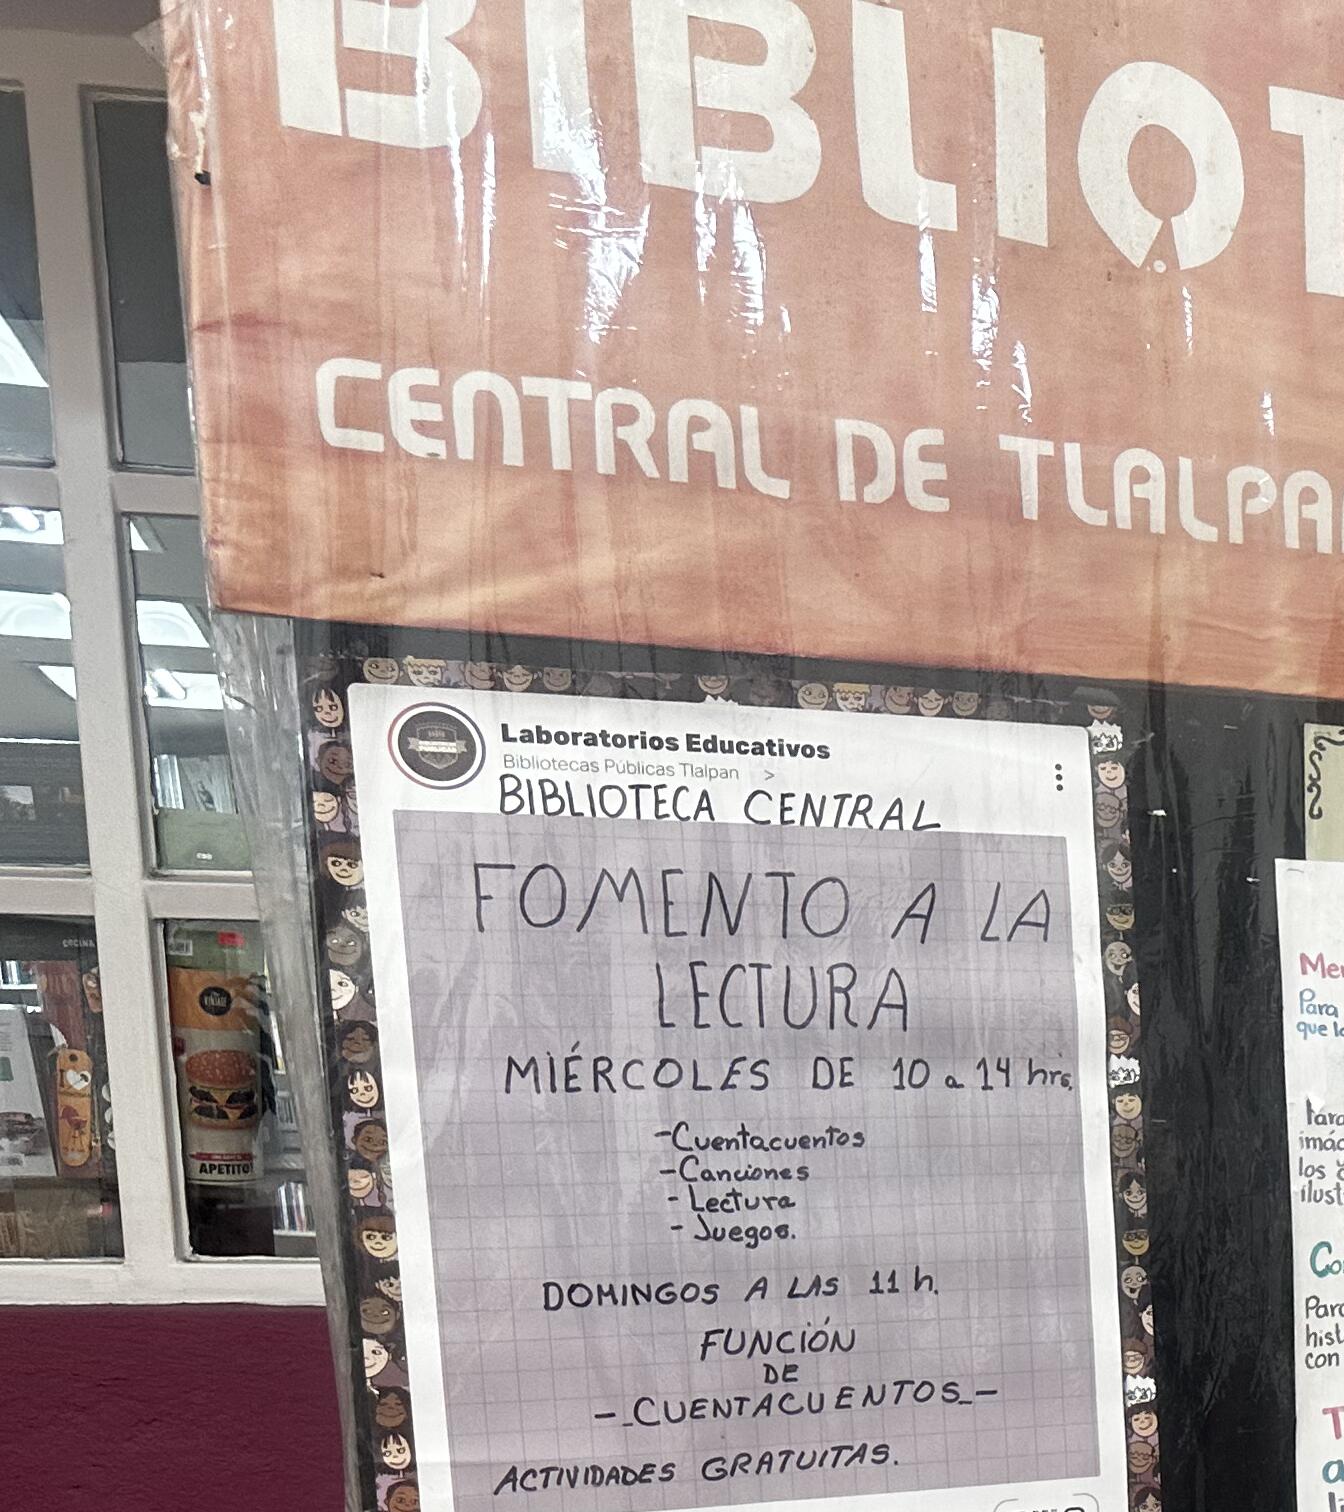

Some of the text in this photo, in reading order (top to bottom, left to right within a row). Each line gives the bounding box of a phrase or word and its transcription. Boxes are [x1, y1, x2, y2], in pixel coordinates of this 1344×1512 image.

[316, 357, 790, 499] CENTRAL
[835, 419, 950, 512] DE
[501, 723, 831, 760] Laboratorios Educativos
[503, 753, 740, 782] Bibliotecas Públicas Tlalpan
[499, 773, 942, 832] BIBLIOTECA CENTRAL
[473, 862, 1052, 945] FOMENTO A LA
[656, 961, 910, 1033] LECTURA
[503, 1041, 772, 1096] MIÉRCOLES
[810, 1056, 856, 1090] DE
[892, 1056, 931, 1091] 10
[945, 1073, 964, 1090] a
[975, 1055, 1012, 1091] 14
[542, 1280, 721, 1312] DOMINGOS
[744, 1275, 770, 1303] A
[787, 1275, 841, 1299] LAS
[868, 1270, 900, 1296] 11
[699, 1316, 856, 1362] FUNCIÓN
[763, 1361, 800, 1384] DE
[493, 1461, 677, 1497] ACTIVIDADES
